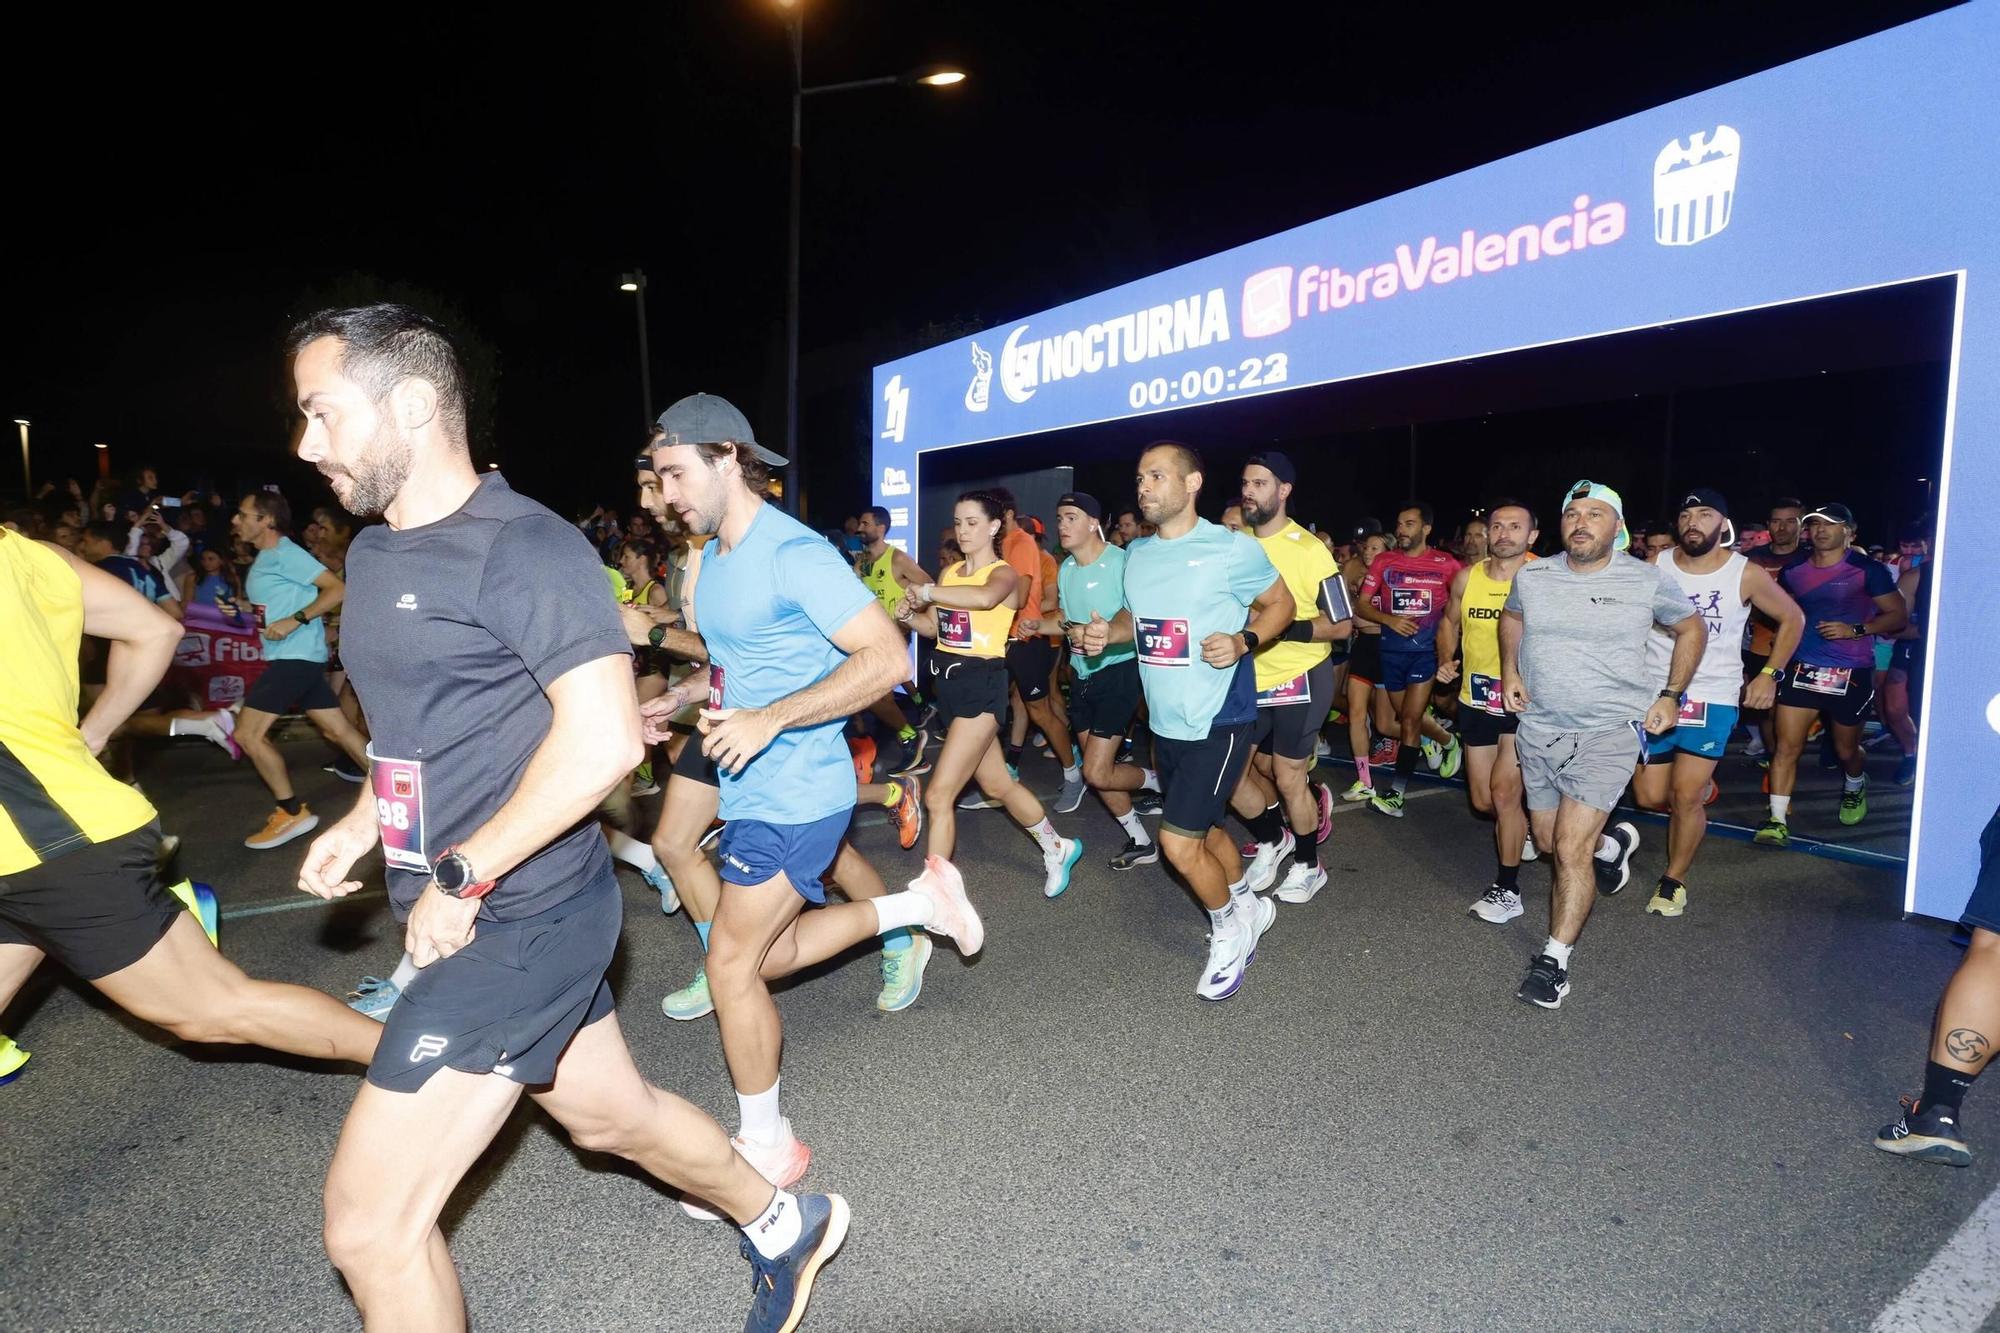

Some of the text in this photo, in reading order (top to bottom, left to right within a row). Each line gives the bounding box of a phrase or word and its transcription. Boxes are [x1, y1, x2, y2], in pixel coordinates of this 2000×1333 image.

[1042, 288, 1231, 384] NOCTURNA
[1398, 598, 1423, 607] 3144
[1145, 634, 1173, 650] 975
[377, 797, 410, 831] 98
[760, 1201, 786, 1234] FILA
